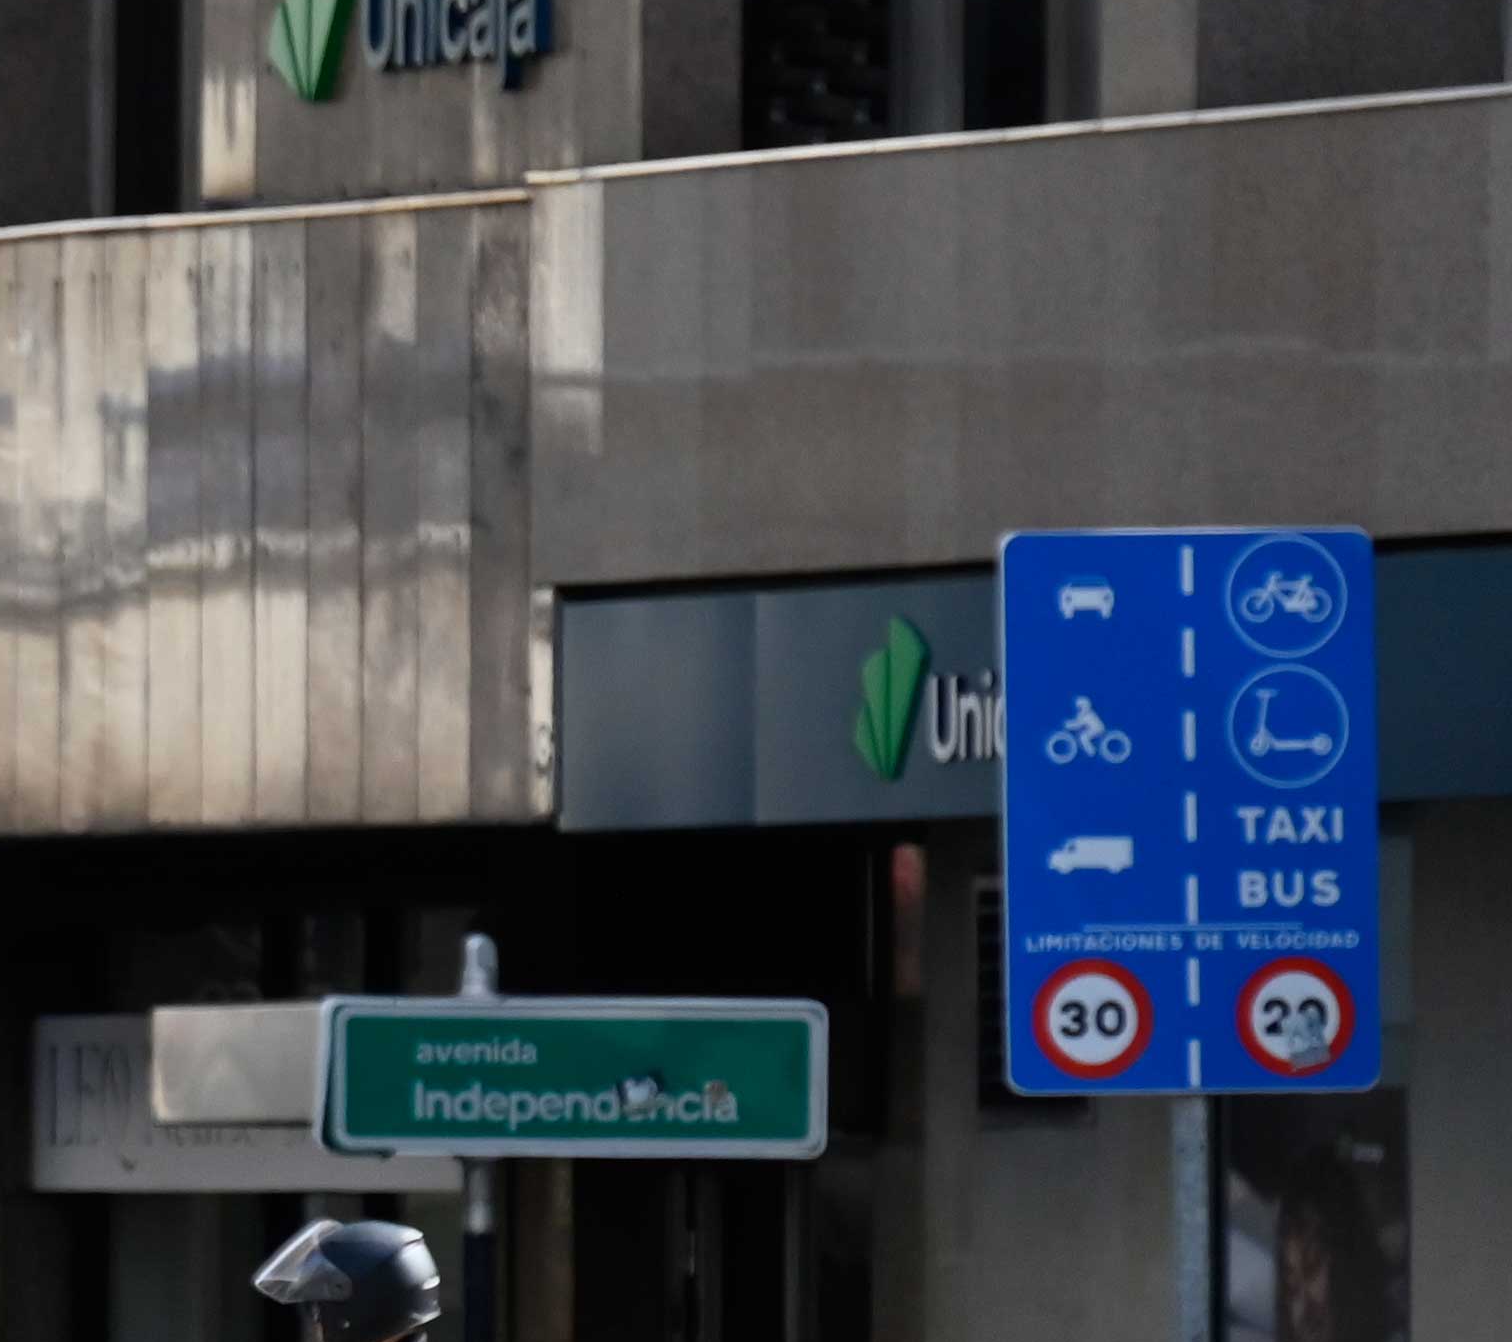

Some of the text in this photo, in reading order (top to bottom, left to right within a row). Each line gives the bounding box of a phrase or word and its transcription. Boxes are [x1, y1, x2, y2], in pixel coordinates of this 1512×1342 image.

[1237, 805, 1344, 844] TAXI
[1238, 869, 1341, 908] BUS
[1026, 929, 1359, 953] LIMITACIONES DE VELOCIDAD
[1060, 1000, 1127, 1038] 30
[416, 1037, 538, 1065] avenida
